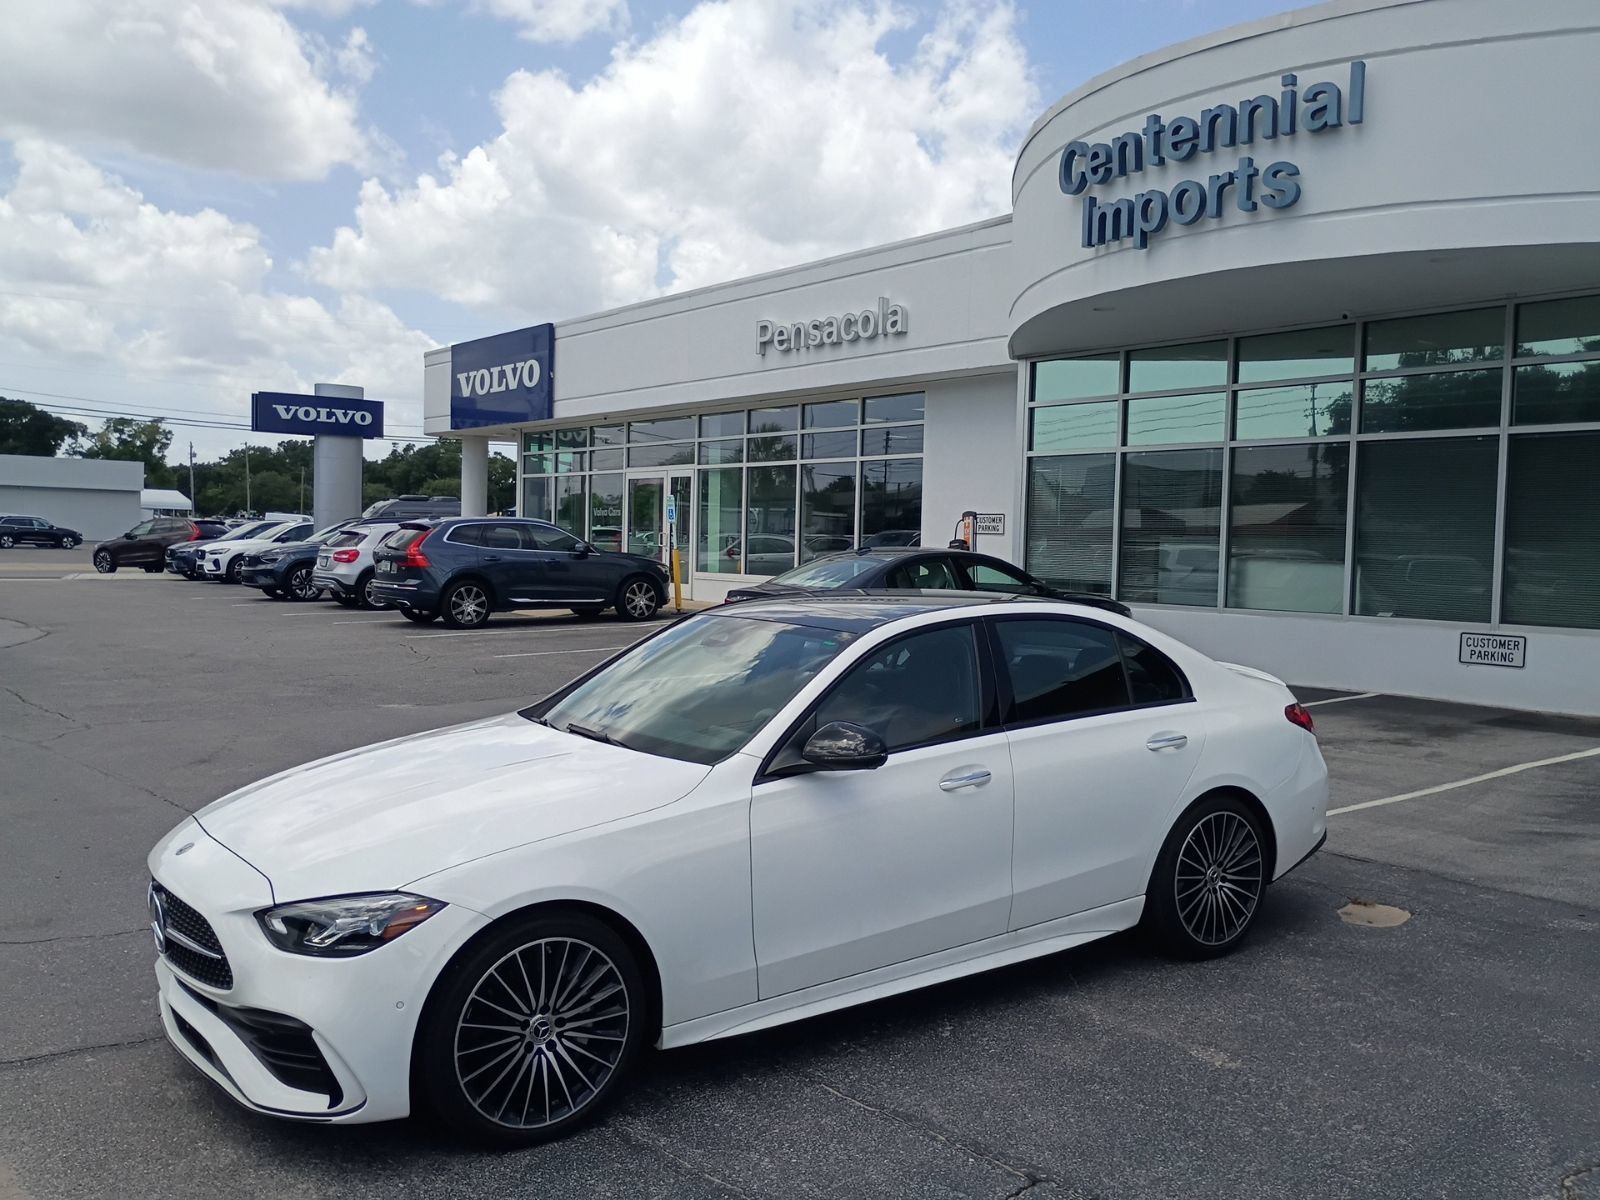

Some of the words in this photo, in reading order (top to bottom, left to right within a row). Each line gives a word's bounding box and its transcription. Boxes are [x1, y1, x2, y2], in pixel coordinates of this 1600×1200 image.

[1058, 60, 1366, 196] Centennial
[1081, 156, 1302, 250] Imports
[755, 297, 908, 357] Pensacola
[457, 359, 541, 398] VOLVO
[272, 404, 373, 426] VOLVO
[977, 524, 1000, 532] PARKING
[1465, 637, 1520, 651] CUSTOMER
[1469, 649, 1515, 663] PARKING
